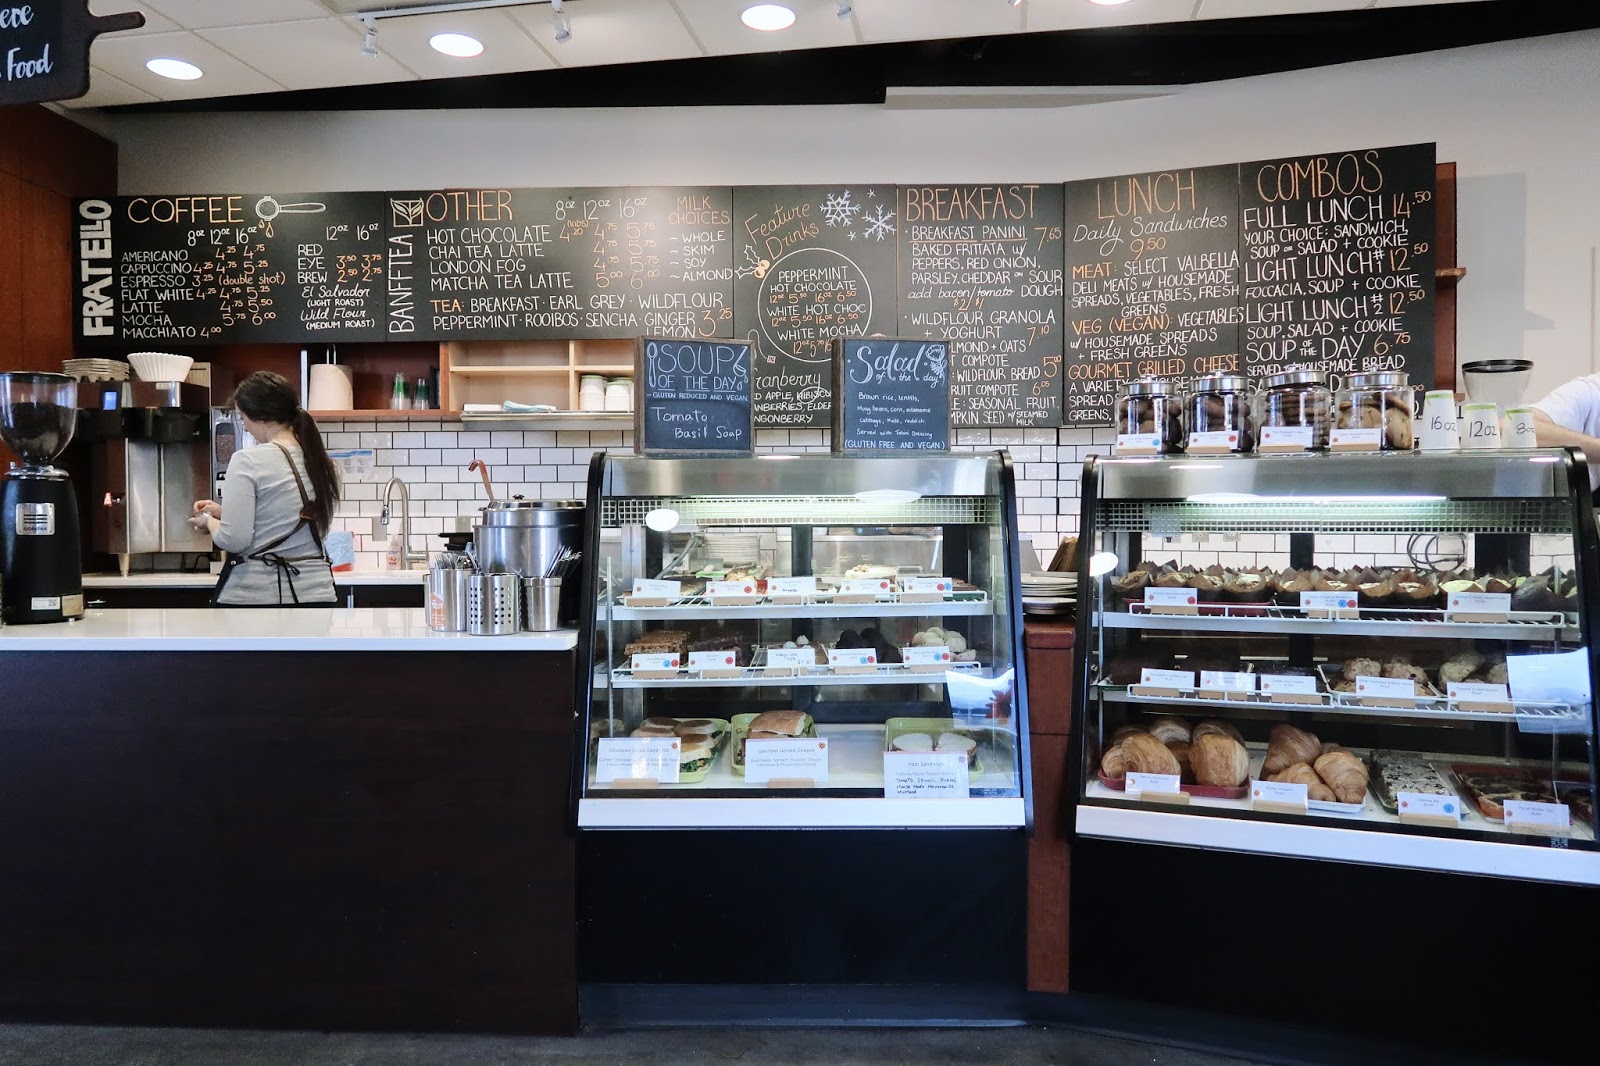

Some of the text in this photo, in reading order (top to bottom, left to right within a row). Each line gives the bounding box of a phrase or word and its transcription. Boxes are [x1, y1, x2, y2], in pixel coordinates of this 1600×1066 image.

[7, 43, 53, 81] Food
[1257, 150, 1383, 202] COMBOS
[1097, 170, 1195, 219] LUNCH
[127, 196, 244, 223] COFFEE
[426, 190, 513, 221] OTHER
[677, 196, 711, 210] MILK
[906, 185, 1039, 221] BREAKFAST
[668, 211, 730, 225] CHOICES
[1244, 205, 1297, 229] FULL
[1307, 194, 1383, 225] LUNCH
[745, 203, 810, 244] Feature
[427, 225, 552, 244] HOT CHOCOLATE
[682, 230, 725, 243] WHOLE
[912, 225, 975, 240] BREAKFAST
[982, 225, 1026, 239] PANINI
[1073, 207, 1228, 256] Daily Sandwiches
[1244, 230, 1275, 246] YOUR
[1279, 226, 1328, 242] CHOICE:
[765, 222, 820, 260] Drinks
[1250, 234, 1409, 260] SOUP SALAD COOKIE
[122, 250, 188, 262] AMERICANO
[298, 244, 323, 256] RED
[429, 243, 544, 259] CHAI TEA LATTE
[683, 245, 715, 255] SKIM
[912, 243, 1005, 256] BAKED FRITTATA
[79, 200, 114, 336] FRATELLO
[121, 263, 192, 274] CAPPUCCINO
[298, 257, 325, 270] EYE
[430, 259, 526, 275] LONDON FOG
[684, 257, 706, 268] SOY
[966, 257, 989, 269] RED
[1124, 257, 1168, 276] SELECT
[1177, 250, 1240, 271] VALBELLA
[1245, 257, 1297, 283] LIGHT
[121, 271, 285, 288] ESPRESSO (double shot)
[297, 272, 327, 284] BREW
[682, 269, 733, 281] ALMOND
[778, 266, 848, 282] PEPPERMINT
[962, 270, 1063, 284] CHEDDAR SOUR
[1103, 268, 1235, 292] MEATS HOUSEMADE
[319, 283, 370, 298] Salvador
[431, 276, 488, 291] MATCHA
[770, 280, 857, 293] HOT CHOCOLATE
[1309, 278, 1344, 294] SOUP
[121, 289, 194, 301] FLAT WHITE
[908, 287, 932, 299] add
[1021, 285, 1063, 296] DOUGH
[1071, 285, 1239, 308] SPREADS, VEGETABLES, FRESH
[430, 292, 723, 313] TEA: EARL GREY WILDFLOUR
[300, 307, 366, 321] Wild Flour
[766, 304, 866, 317] WHITE CHOC
[990, 309, 1056, 324] GRANOLA
[1121, 303, 1167, 319] GREENS
[1246, 301, 1294, 324] LIGHT
[122, 315, 172, 326] MOCHA
[306, 321, 340, 330] (MEDIUM
[433, 312, 695, 330] PEPPERMINT ROOIBOS SENCHA GINGER
[1072, 319, 1102, 335] VEG
[1177, 306, 1244, 327] VEGETABLES
[123, 327, 195, 338] MACCHIATO
[820, 324, 863, 337] MOCHA
[940, 326, 1002, 339] YOGHURT
[1085, 327, 1218, 349] HOUSEMADE SPREADS
[1000, 340, 1026, 352] OATS
[1322, 333, 1365, 360] DAY
[658, 344, 734, 375] SOUP
[850, 343, 926, 384] Salad
[962, 354, 1009, 366] COMPOTE
[1068, 354, 1239, 380] GOURMET GRILLED CHEESE
[1247, 363, 1280, 377] SERVED
[1363, 355, 1405, 371] BREAD
[658, 375, 736, 390] OF THE DAY
[899, 371, 938, 388] the day
[859, 392, 879, 400] Brown
[969, 397, 1021, 410] SEASONAL
[651, 407, 707, 422] Tomato
[675, 425, 707, 439] Basil
